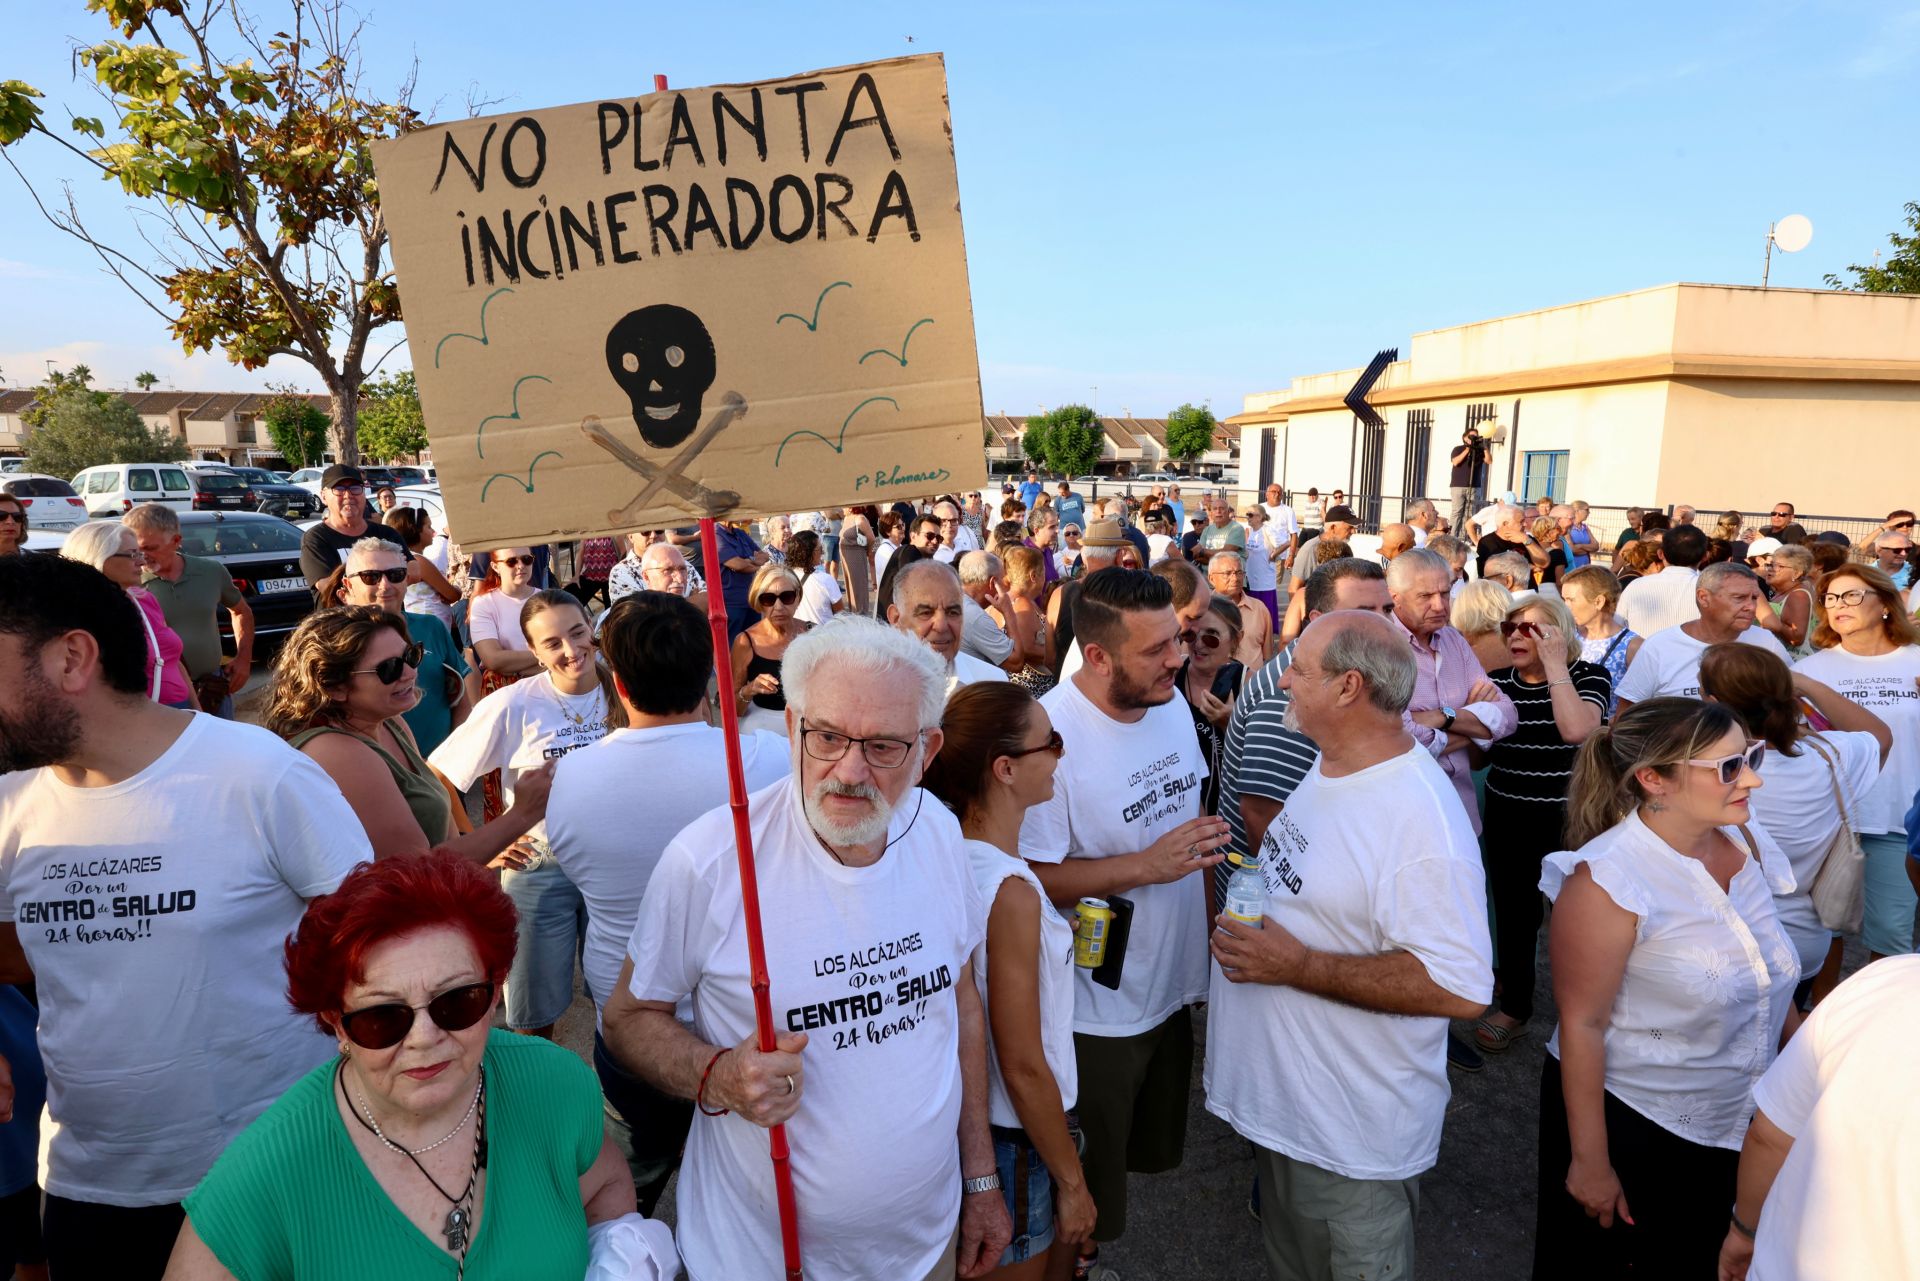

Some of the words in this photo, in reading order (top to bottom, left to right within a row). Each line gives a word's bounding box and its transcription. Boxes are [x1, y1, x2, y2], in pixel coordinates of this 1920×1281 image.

[430, 116, 547, 194] NO
[597, 72, 902, 175] PLANTA
[265, 579, 292, 591] 0947
[1683, 687, 1700, 696] CE
[1878, 690, 1918, 699] SALUD
[556, 728, 572, 737] LOS
[1127, 772, 1142, 787] LOS
[1142, 752, 1180, 779] ALCÁZARES
[1163, 772, 1197, 798] SALUD
[42, 863, 66, 880] LOS
[69, 856, 162, 878] ALCÁZARES
[1275, 857, 1303, 895] SALUD
[65, 881, 103, 895] Por
[107, 881, 128, 894] un
[19, 899, 95, 923] CENTRO
[97, 904, 110, 914] de
[112, 889, 196, 918] SALUD
[45, 928, 71, 944] 24
[77, 919, 152, 944] horas!!
[814, 955, 846, 977] LOS
[850, 932, 923, 970] ALCÁZARES
[849, 971, 887, 990] Por
[890, 965, 908, 980] un
[786, 991, 883, 1032] CENTRO
[884, 993, 895, 1005] de
[897, 964, 952, 1007] SALUD
[833, 1027, 861, 1051] 24
[866, 999, 928, 1045] horas!!
